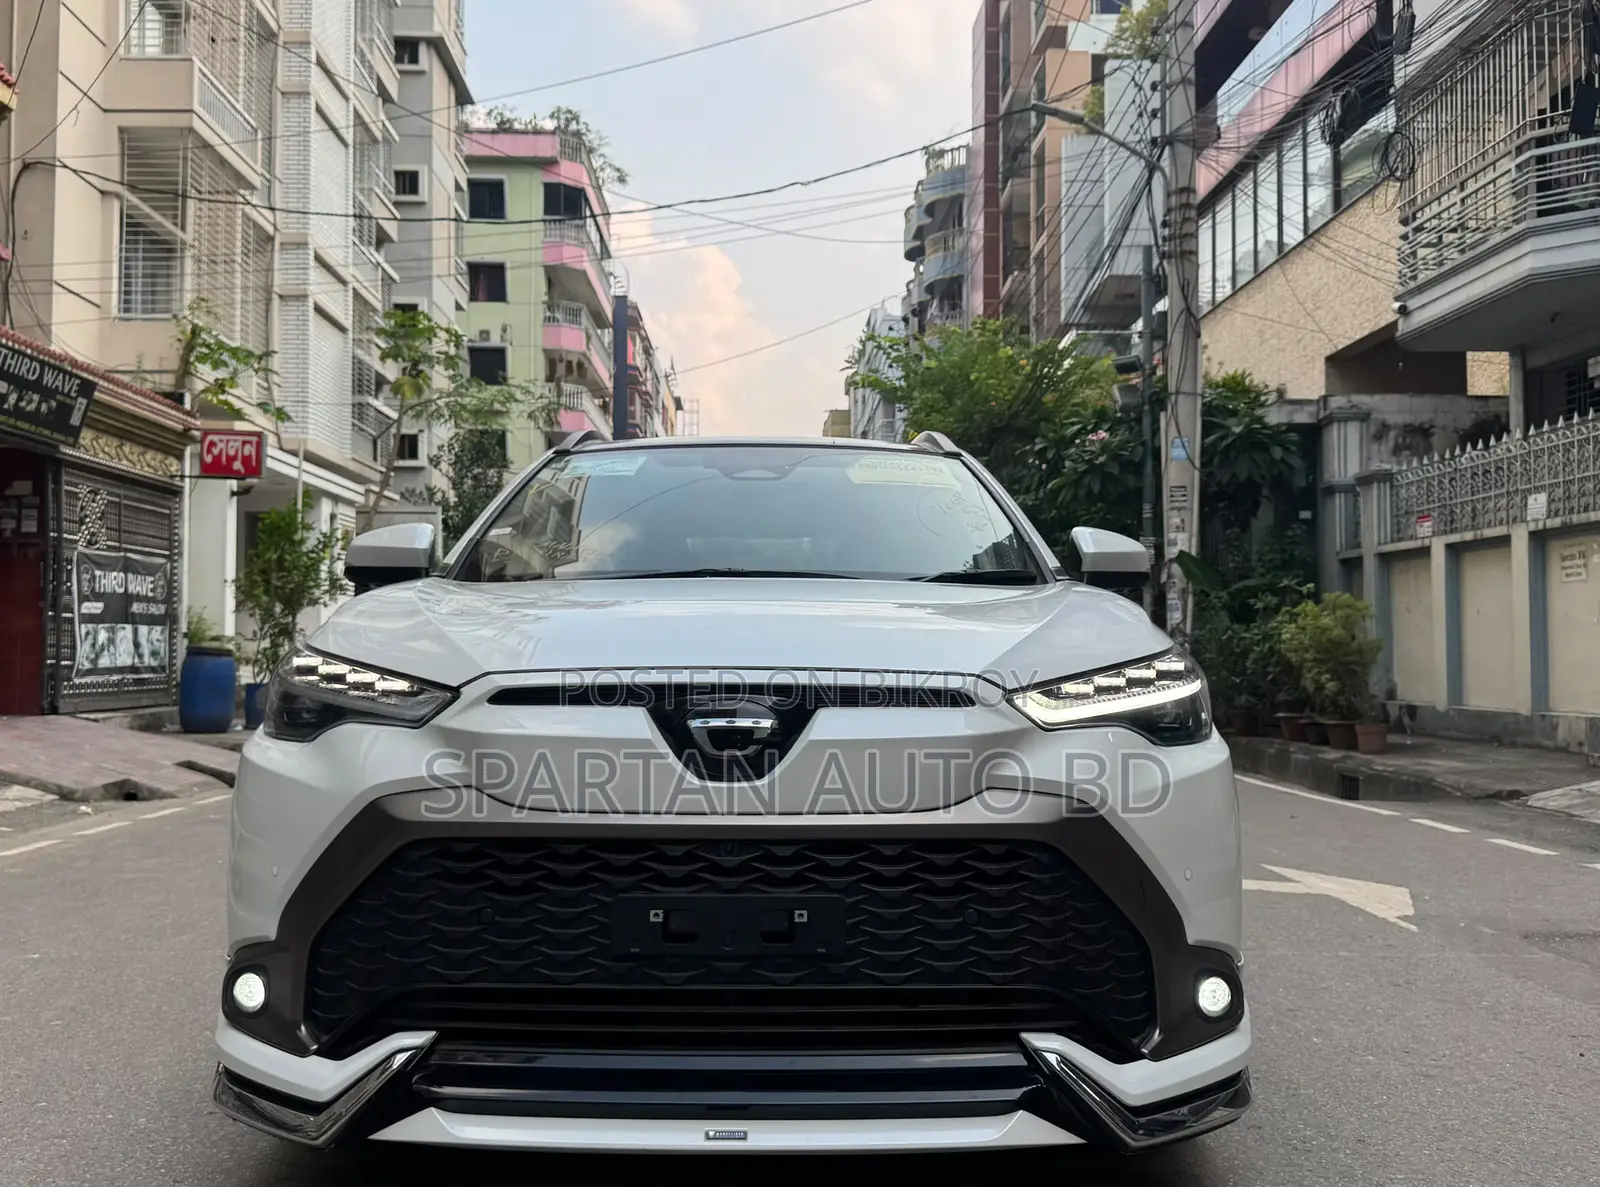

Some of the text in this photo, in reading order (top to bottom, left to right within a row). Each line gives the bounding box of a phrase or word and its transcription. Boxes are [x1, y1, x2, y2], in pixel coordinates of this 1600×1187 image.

[0, 347, 81, 397] THIRD WAVE
[203, 434, 259, 474] সেলুন
[94, 569, 155, 597] THIRD WAVE
